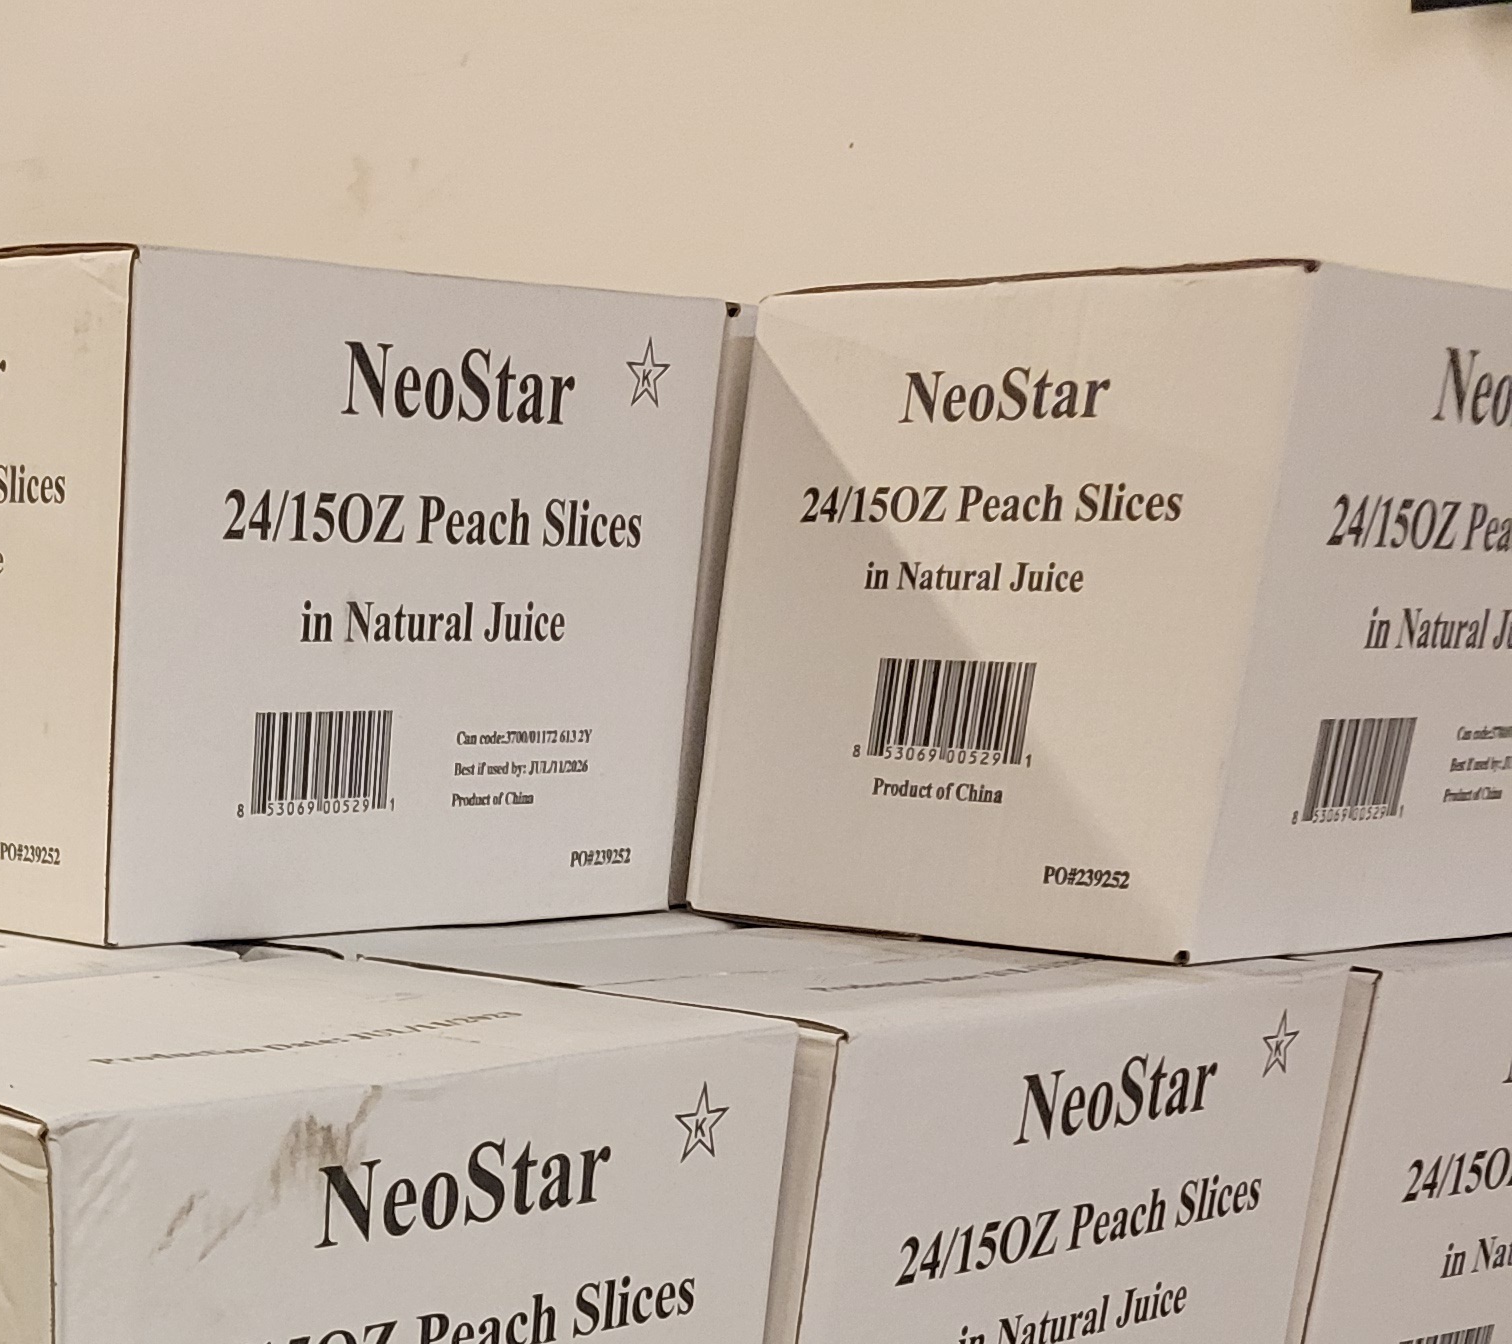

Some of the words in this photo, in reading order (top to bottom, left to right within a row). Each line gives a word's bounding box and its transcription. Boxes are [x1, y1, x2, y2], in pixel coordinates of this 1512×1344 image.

[341, 341, 575, 425] NeoStar
[898, 367, 1110, 423] NeoStar
[223, 489, 404, 543] 24/15OZ
[417, 496, 529, 545] Peach
[543, 499, 641, 548] Slices
[800, 486, 947, 523] 24/15OZ
[956, 484, 1062, 522] Peach
[1075, 483, 1183, 522] Slices
[865, 561, 888, 589] in
[897, 562, 1002, 591] Natural
[1010, 562, 1083, 592] Juice
[300, 600, 332, 642] in
[345, 601, 473, 642] Natural
[484, 601, 565, 642] Juice
[457, 731, 477, 745] Can
[560, 730, 576, 743] 613
[578, 729, 592, 743] 2Y
[454, 763, 475, 776] Best
[477, 762, 486, 775] if
[487, 761, 509, 775] used
[511, 761, 526, 777] by:
[452, 793, 491, 807] Product
[493, 792, 504, 805] of
[505, 792, 534, 805] China
[0, 842, 60, 865] PO#239252
[570, 848, 631, 867] PO#239252
[1043, 866, 1130, 889] PO#239252
[1014, 1054, 1218, 1145] NeoStar
[315, 1138, 611, 1248] NeoStar
[895, 1209, 1060, 1286] 24/15OZ
[1066, 1188, 1166, 1251] Peach
[1175, 1175, 1261, 1227] Slices
[573, 1276, 695, 1338] Slices
